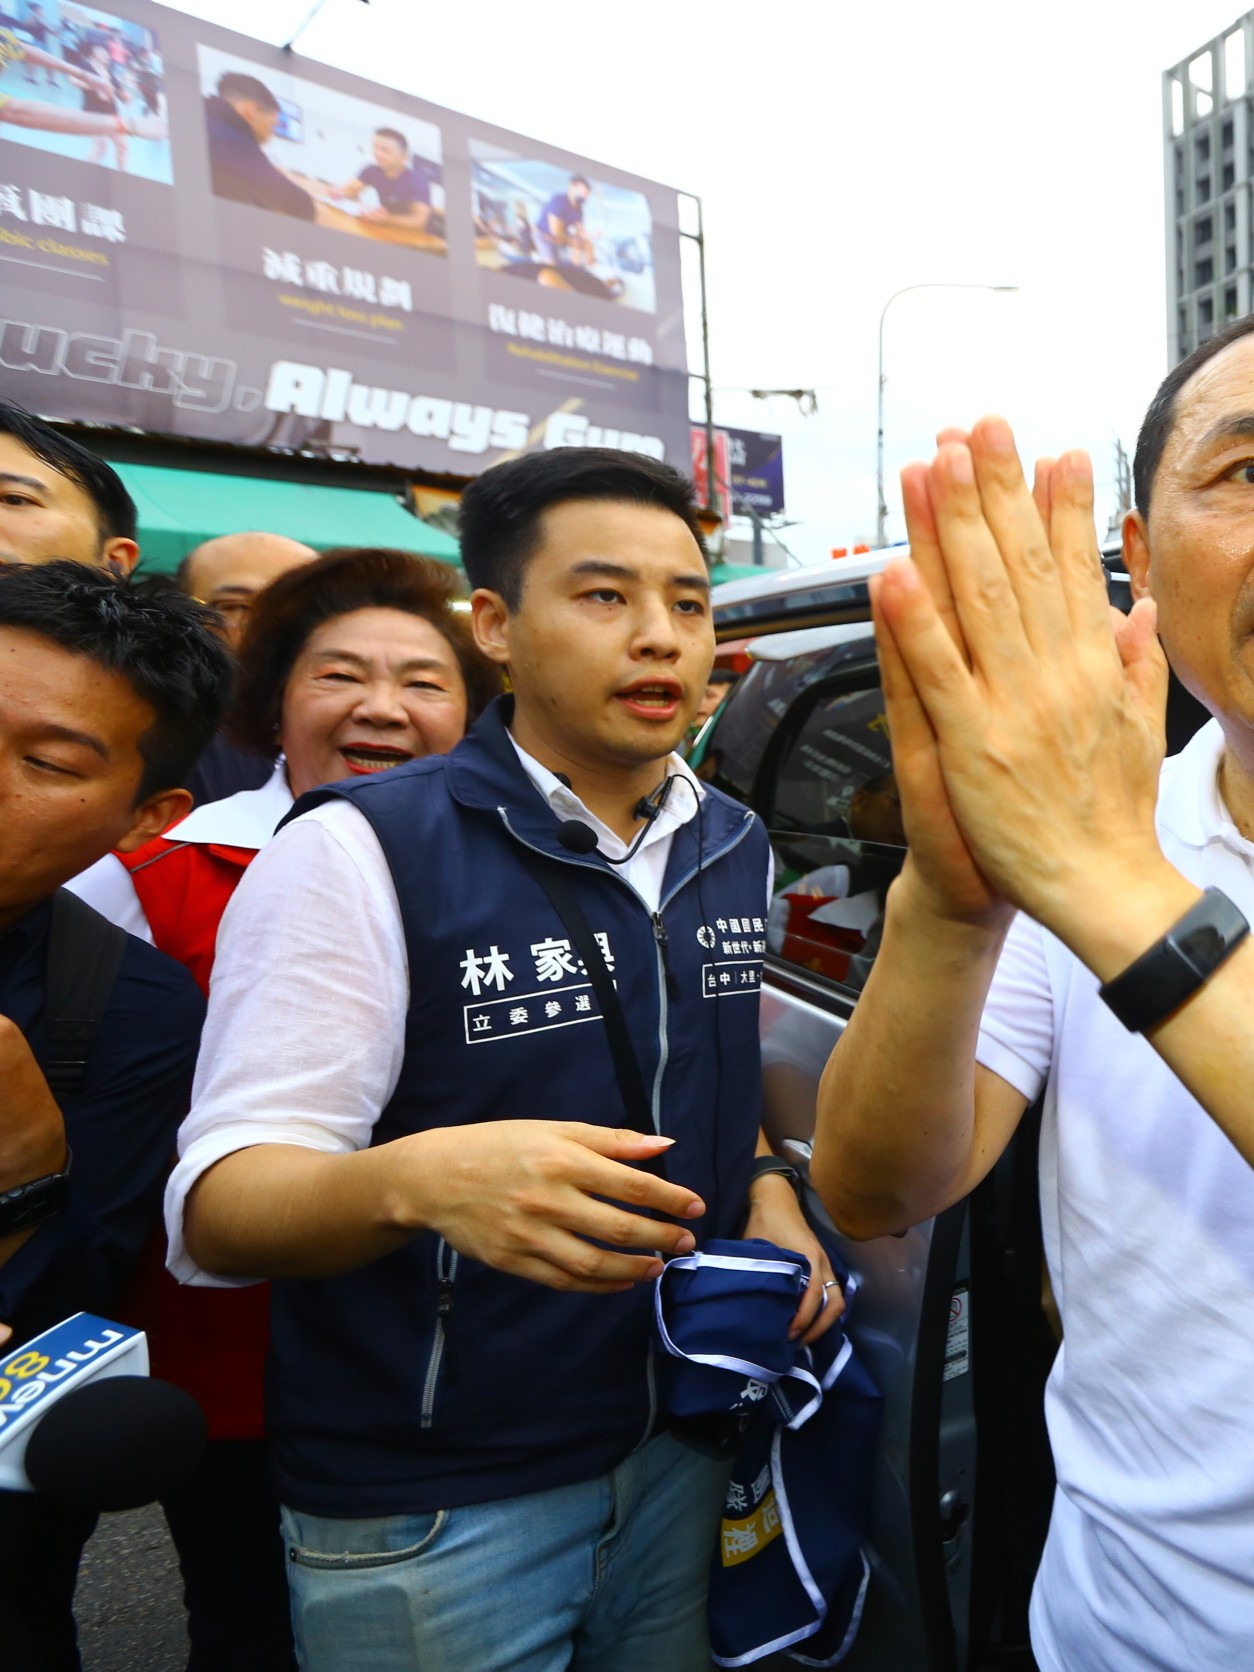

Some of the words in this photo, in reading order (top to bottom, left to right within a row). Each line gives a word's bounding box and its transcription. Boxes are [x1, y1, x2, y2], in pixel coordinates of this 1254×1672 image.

[265, 359, 531, 454] Always
[716, 918, 768, 933] 中國國民
[472, 995, 591, 1032] 立委參選
